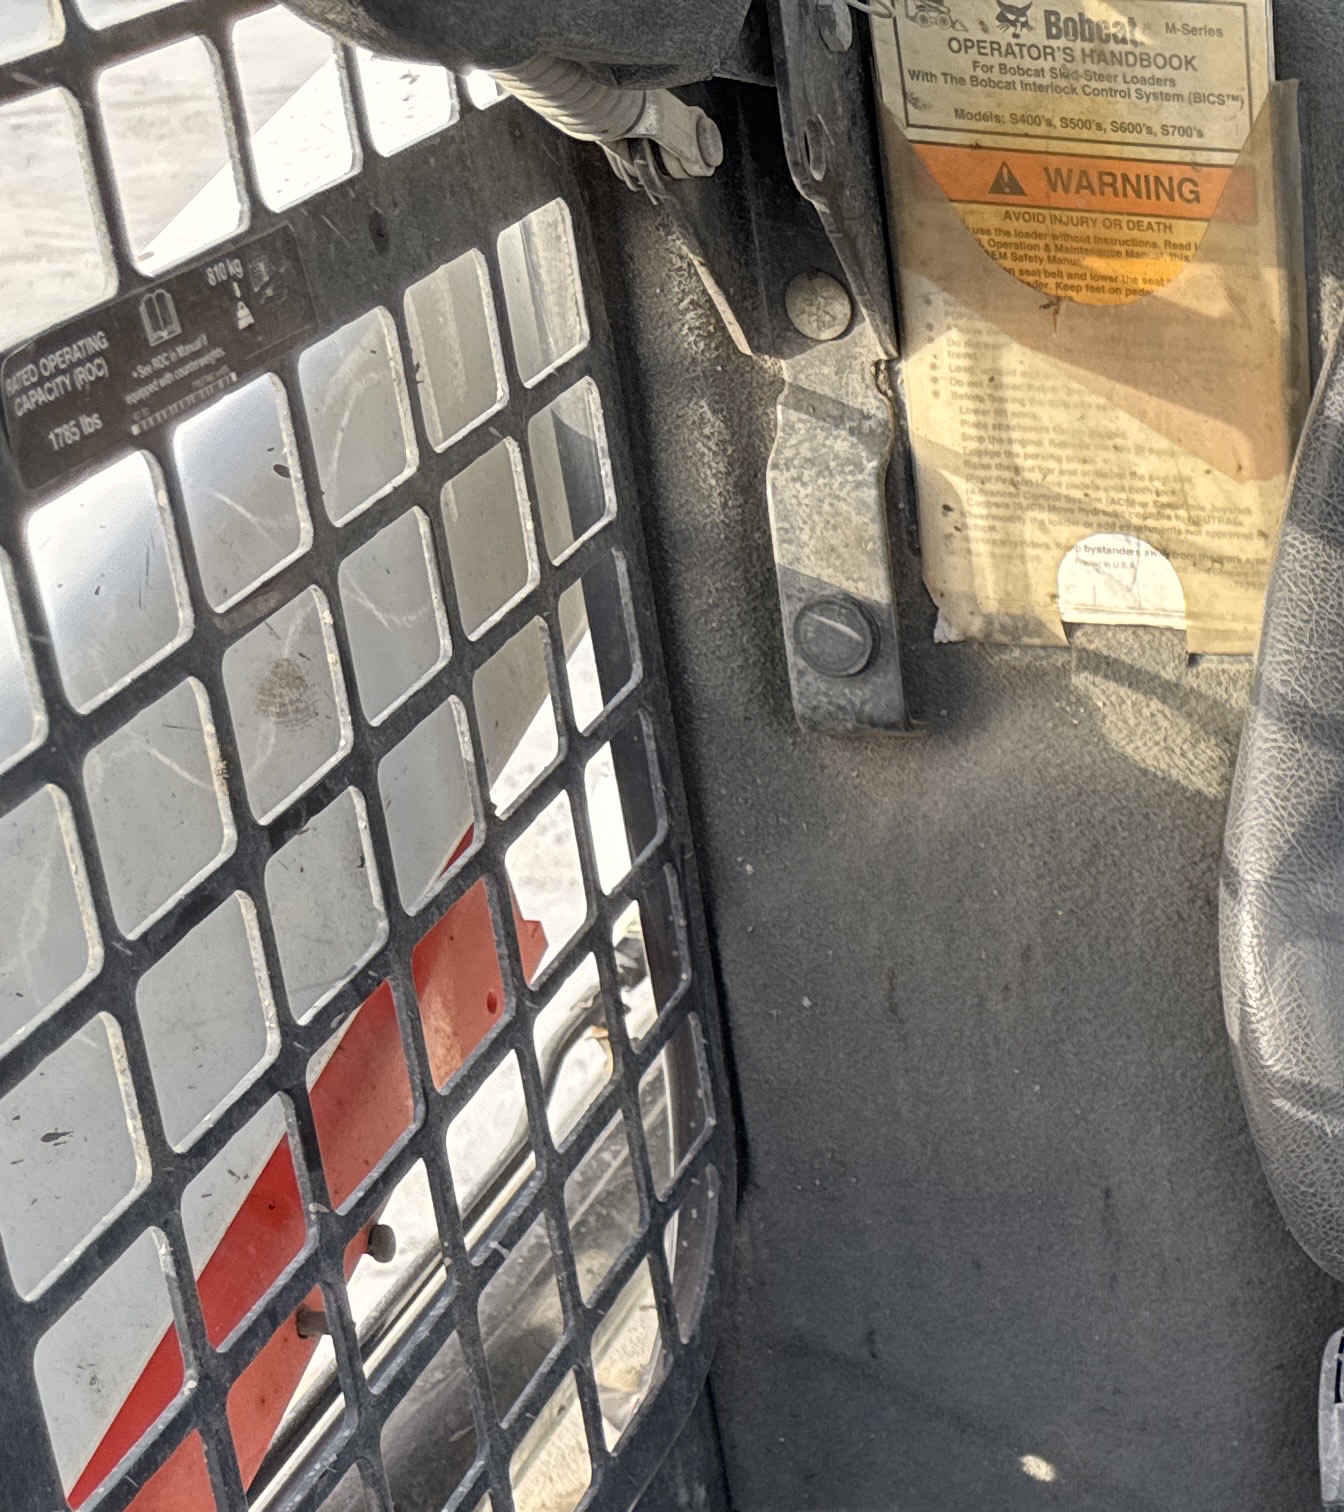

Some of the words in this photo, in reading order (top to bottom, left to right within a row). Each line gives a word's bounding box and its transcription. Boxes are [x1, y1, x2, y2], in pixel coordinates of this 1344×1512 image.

[1043, 9, 1139, 48] Bobcat
[1165, 22, 1224, 37] M-Series
[947, 37, 1076, 64] OPERATOR'S
[1081, 48, 1199, 72] HANDBOOK
[908, 68, 938, 84] With
[941, 72, 966, 87] The
[970, 75, 1018, 91] Bobcat
[1020, 79, 1079, 96] Interlock
[1081, 84, 1132, 100] Control
[1134, 88, 1185, 104] System
[972, 60, 995, 74] For
[998, 63, 1047, 79] Bobcat
[1050, 67, 1119, 84] Skid-Steer
[1122, 73, 1176, 88] Loaders
[954, 108, 1006, 125] Models:
[1160, 124, 1204, 139] S700's
[1042, 165, 1201, 205] WARNING
[1004, 210, 1046, 225] AVOID
[1049, 213, 1097, 228] INJURY
[1102, 217, 1122, 231] OR
[1126, 219, 1173, 234] DEATH
[972, 227, 992, 236] use
[994, 227, 1012, 238] the
[1014, 228, 1048, 241] loader
[1051, 231, 1091, 245] without
[1164, 240, 1192, 252] Read
[987, 238, 1041, 252] Operation
[206, 261, 228, 287] 810
[226, 258, 244, 279] kg
[1010, 251, 1045, 266] Safety
[1018, 268, 1041, 278] seat
[1043, 269, 1065, 280] belt
[1066, 271, 1087, 282] and
[1090, 271, 1118, 284] lower
[1055, 281, 1083, 295] Keep
[1085, 282, 1106, 294] feet
[1108, 286, 1122, 296] on
[5, 363, 39, 398] RATED
[39, 330, 109, 378] OPERATING
[14, 373, 73, 417] CAPACITY
[73, 356, 110, 391] (ROC)
[48, 420, 81, 451] 1785
[79, 413, 103, 436] lbs
